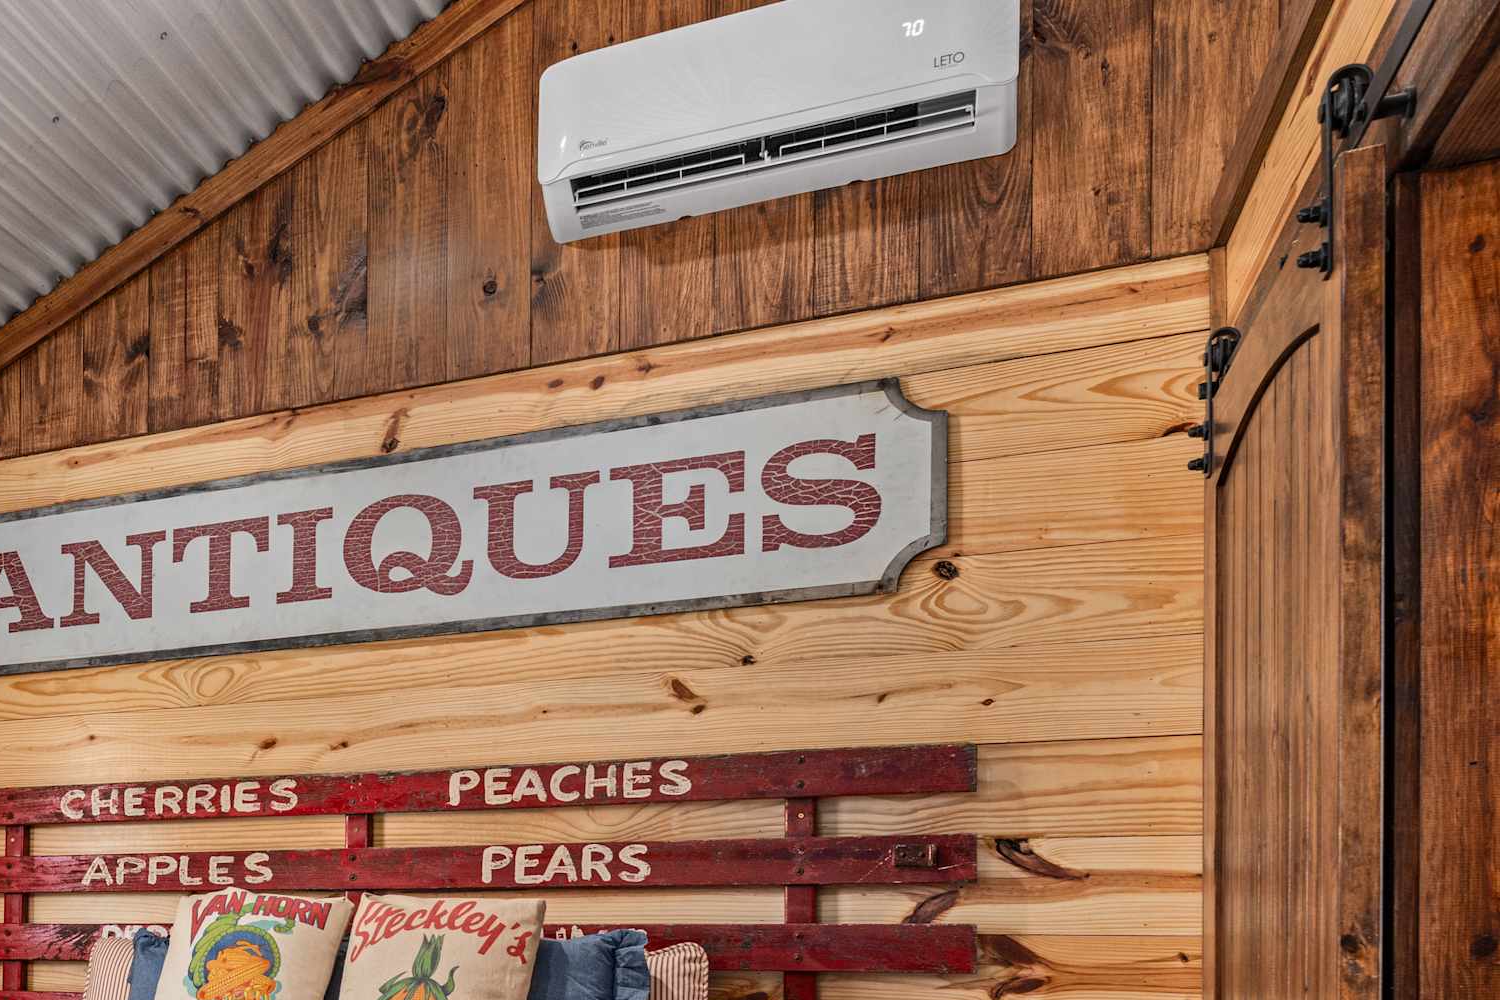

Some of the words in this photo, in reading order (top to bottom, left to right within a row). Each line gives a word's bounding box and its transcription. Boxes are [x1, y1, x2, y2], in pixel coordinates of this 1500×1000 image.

[902, 19, 925, 37] 70
[933, 51, 965, 68] LETO
[60, 778, 299, 820] CHERRIES
[446, 760, 692, 806] PEACHES
[81, 852, 273, 886] APPLES
[481, 844, 650, 884] PEARS
[190, 890, 247, 941] VAN
[252, 894, 332, 931] HORN
[350, 899, 533, 964] Steckley's
